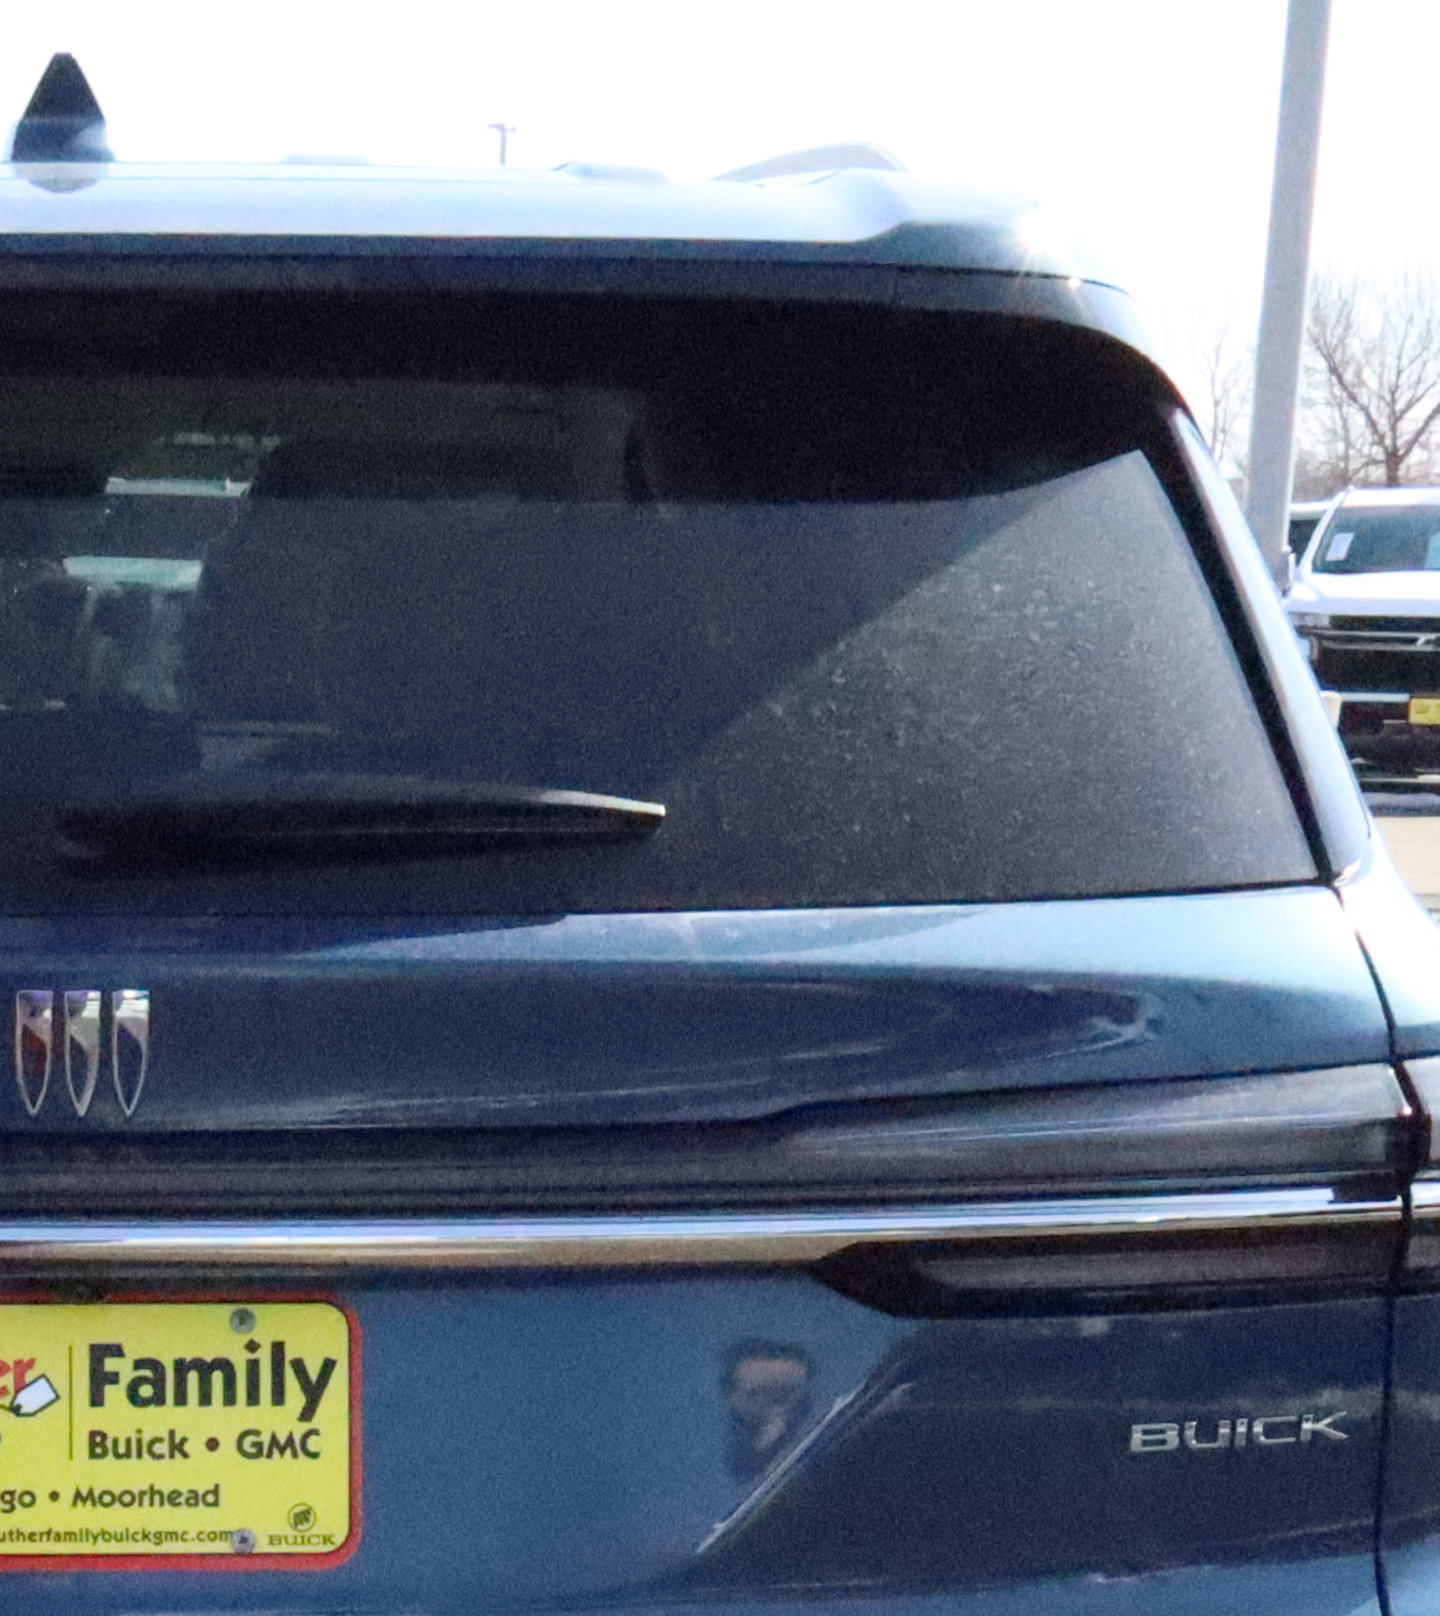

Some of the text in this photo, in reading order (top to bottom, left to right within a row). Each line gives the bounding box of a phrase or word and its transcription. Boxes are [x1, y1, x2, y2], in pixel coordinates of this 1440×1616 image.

[87, 1340, 338, 1421] Family
[87, 1428, 321, 1460] Buick GMC
[1130, 1411, 1349, 1452] BUICK
[72, 1483, 220, 1508] Moorhead
[267, 1533, 337, 1546] BUICK
